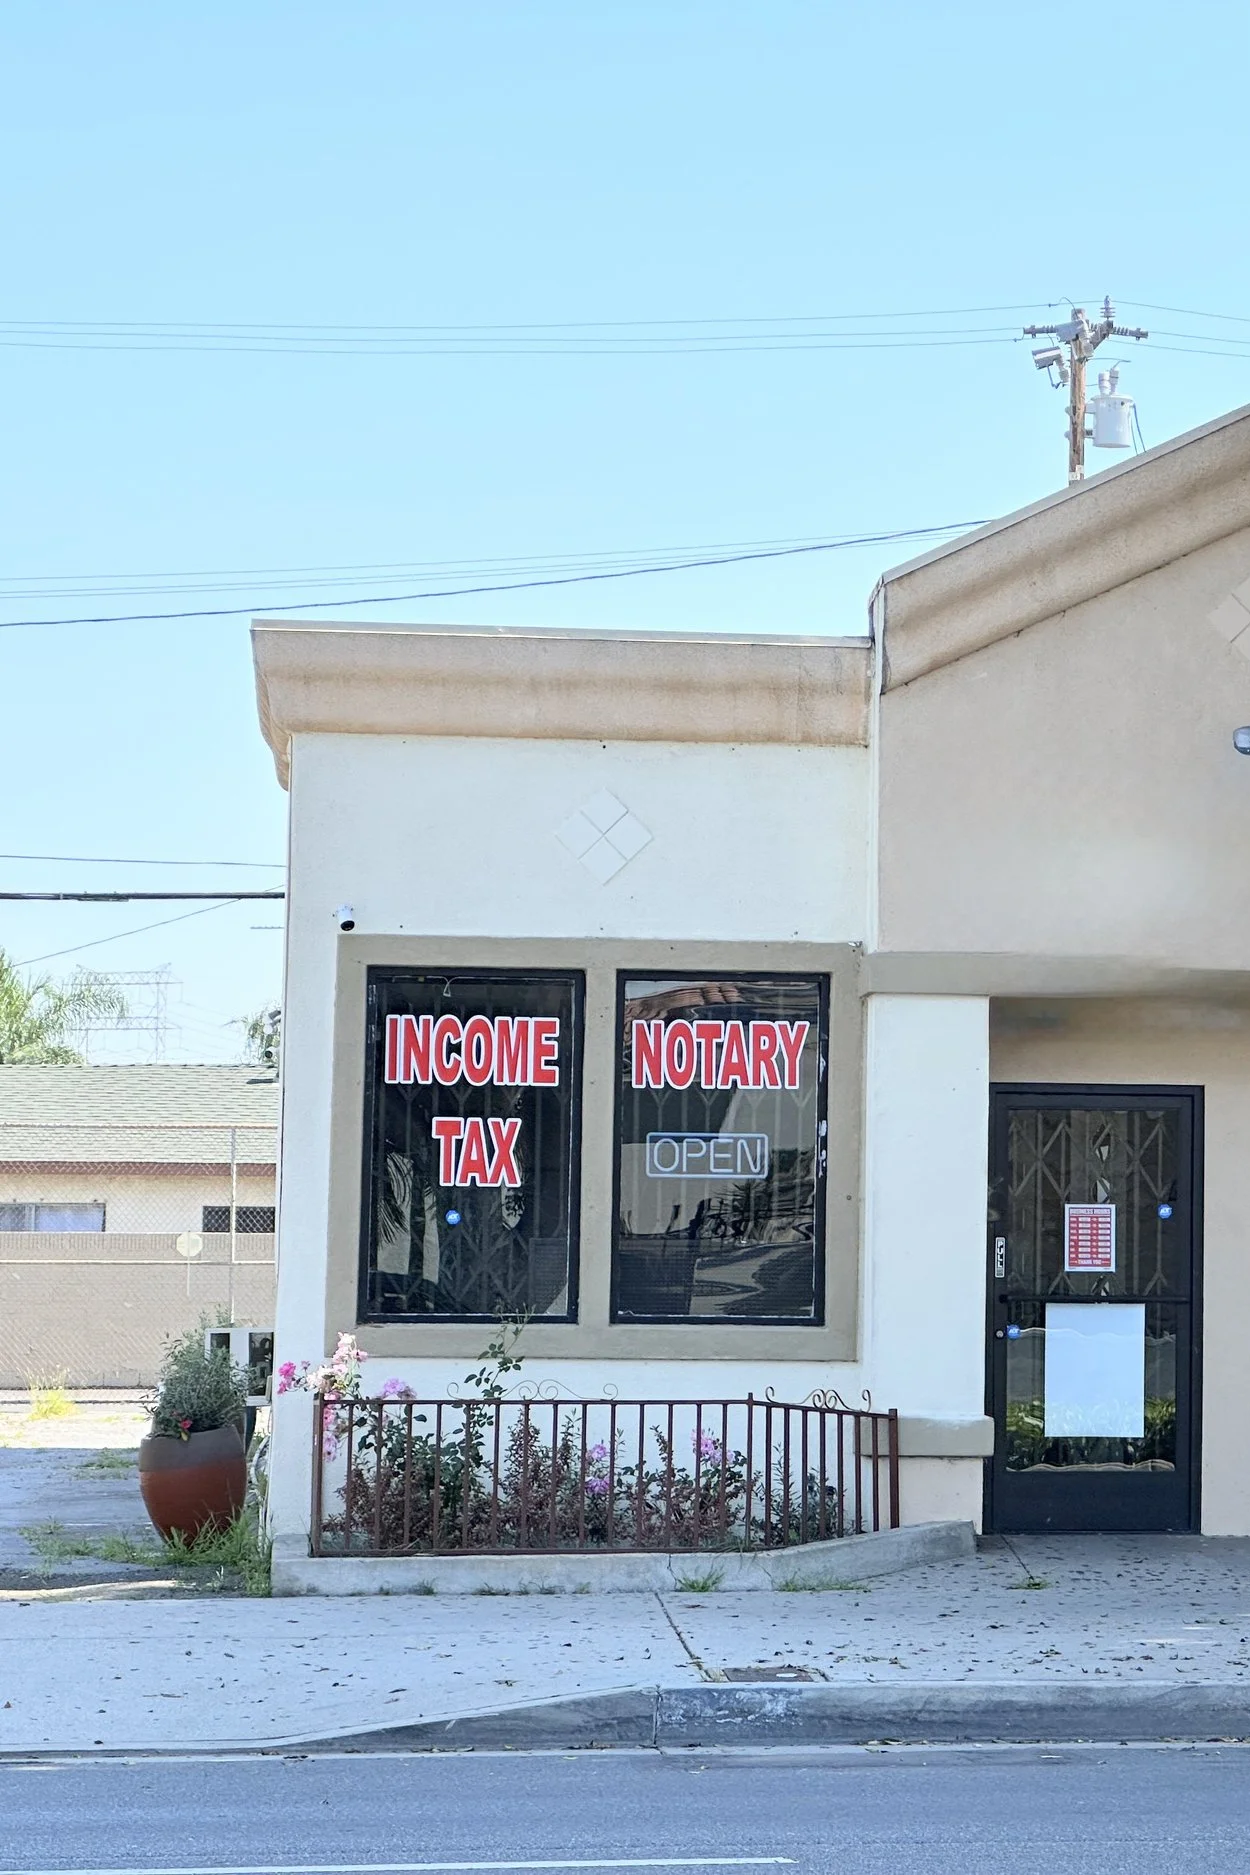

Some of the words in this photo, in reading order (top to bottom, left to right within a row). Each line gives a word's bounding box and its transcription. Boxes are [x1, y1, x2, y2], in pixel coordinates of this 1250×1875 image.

[385, 1014, 560, 1086] INCOME
[632, 1019, 810, 1090] NOTARY
[432, 1117, 522, 1187] TAX
[653, 1138, 762, 1173] OPEN
[996, 1240, 1004, 1268] PULL
